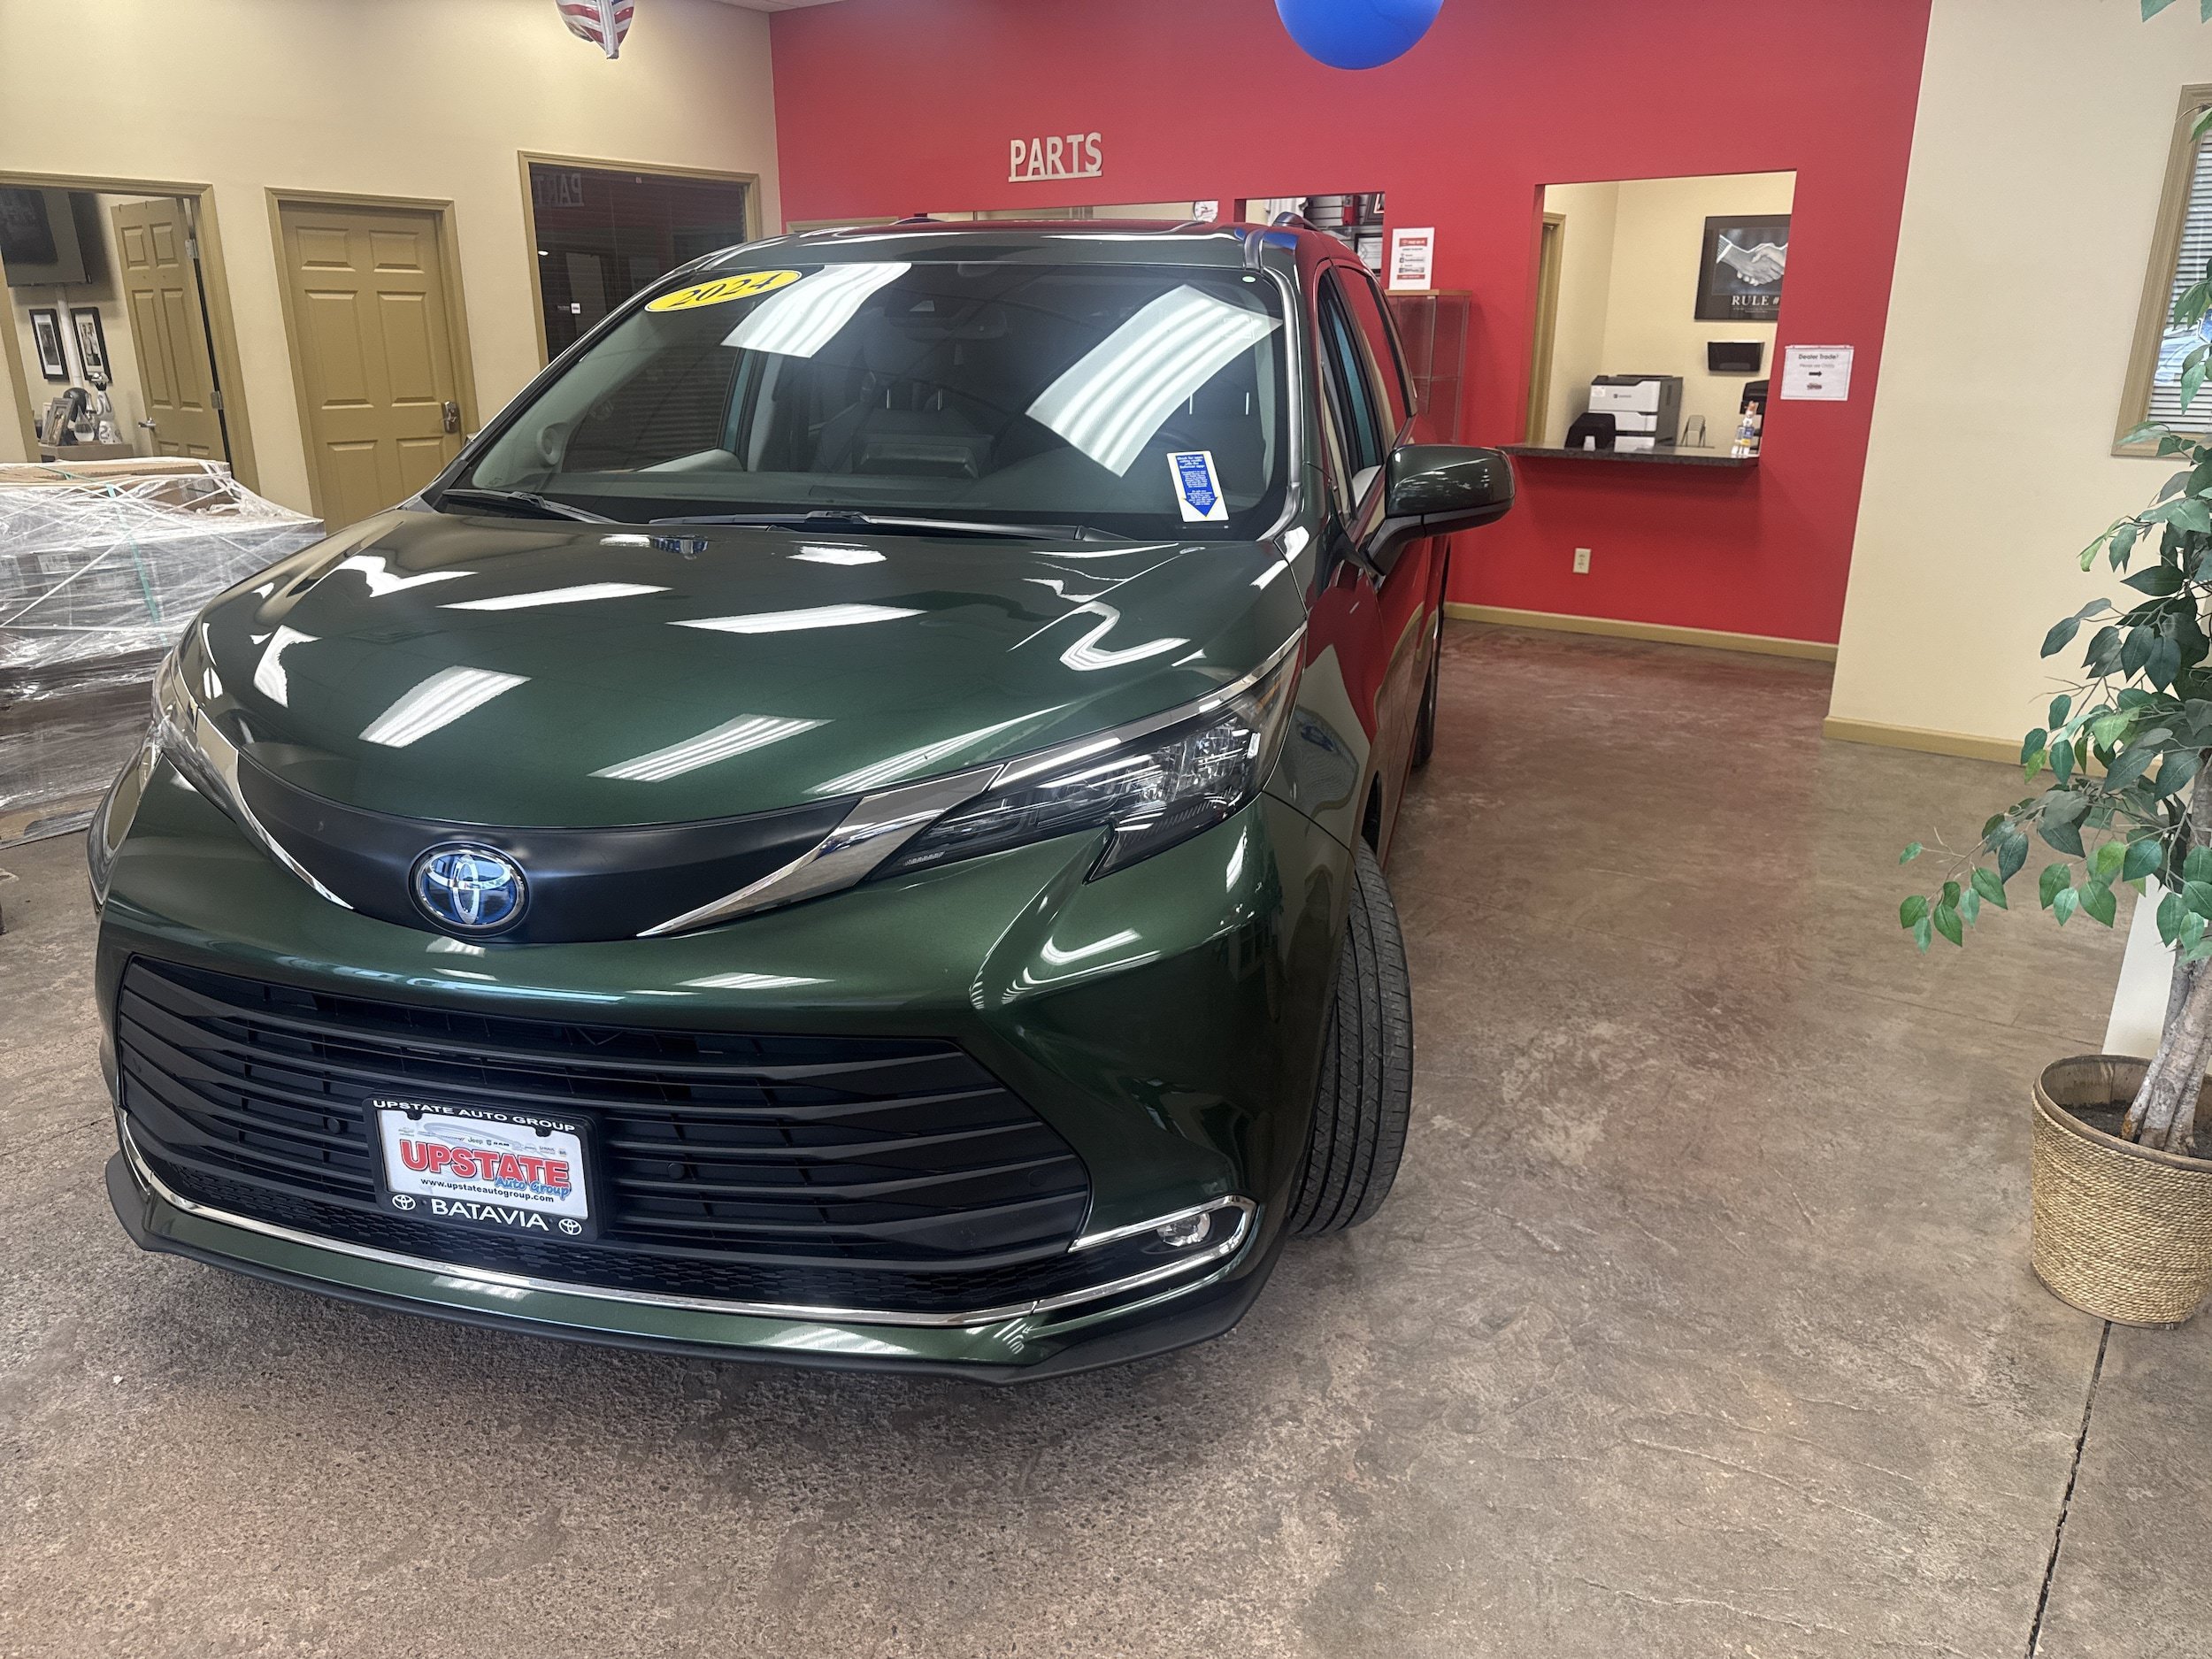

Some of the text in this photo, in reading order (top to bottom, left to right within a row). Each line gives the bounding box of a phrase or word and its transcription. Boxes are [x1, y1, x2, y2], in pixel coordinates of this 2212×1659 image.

[1010, 132, 1102, 178] PARTS
[668, 273, 783, 308] 2024
[1732, 295, 1770, 306] RULE
[373, 1099, 576, 1133] UPSTATE AUTO GROUP
[467, 1136, 484, 1145] Jeep
[400, 1139, 572, 1189] UPSTATE
[420, 1178, 555, 1203] www.upstateautogroup.com
[494, 1176, 572, 1201] Auto Group
[431, 1198, 549, 1232] BATAVIA
